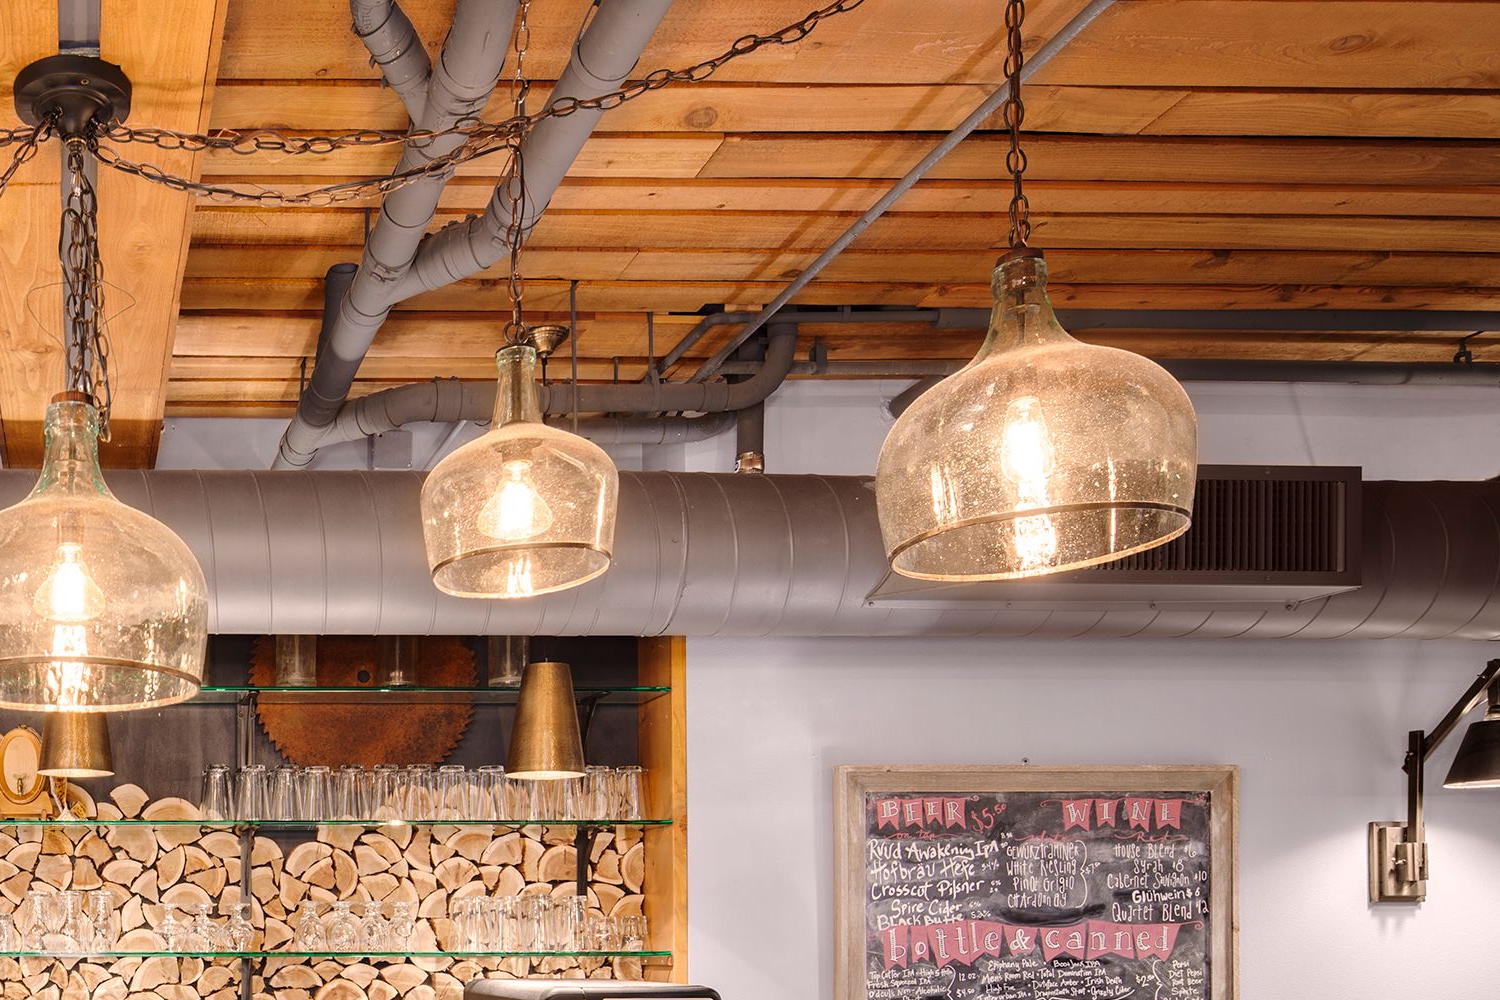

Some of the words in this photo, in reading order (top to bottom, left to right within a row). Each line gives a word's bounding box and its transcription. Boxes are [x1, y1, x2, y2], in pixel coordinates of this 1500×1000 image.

[881, 800, 962, 821] BEER
[1066, 800, 1174, 823] WINE
[940, 858, 975, 880] Hefe
[1134, 859, 1163, 874] Syrah
[871, 881, 933, 901] Crosscut
[936, 880, 985, 899] Pilsner
[891, 899, 924, 918] Spire
[928, 899, 962, 917] Cider
[1112, 902, 1153, 922] Quartet
[889, 921, 999, 961] bottle
[1010, 929, 1031, 950] &
[1045, 926, 1169, 951] canned
[1022, 959, 1038, 968] Pale
